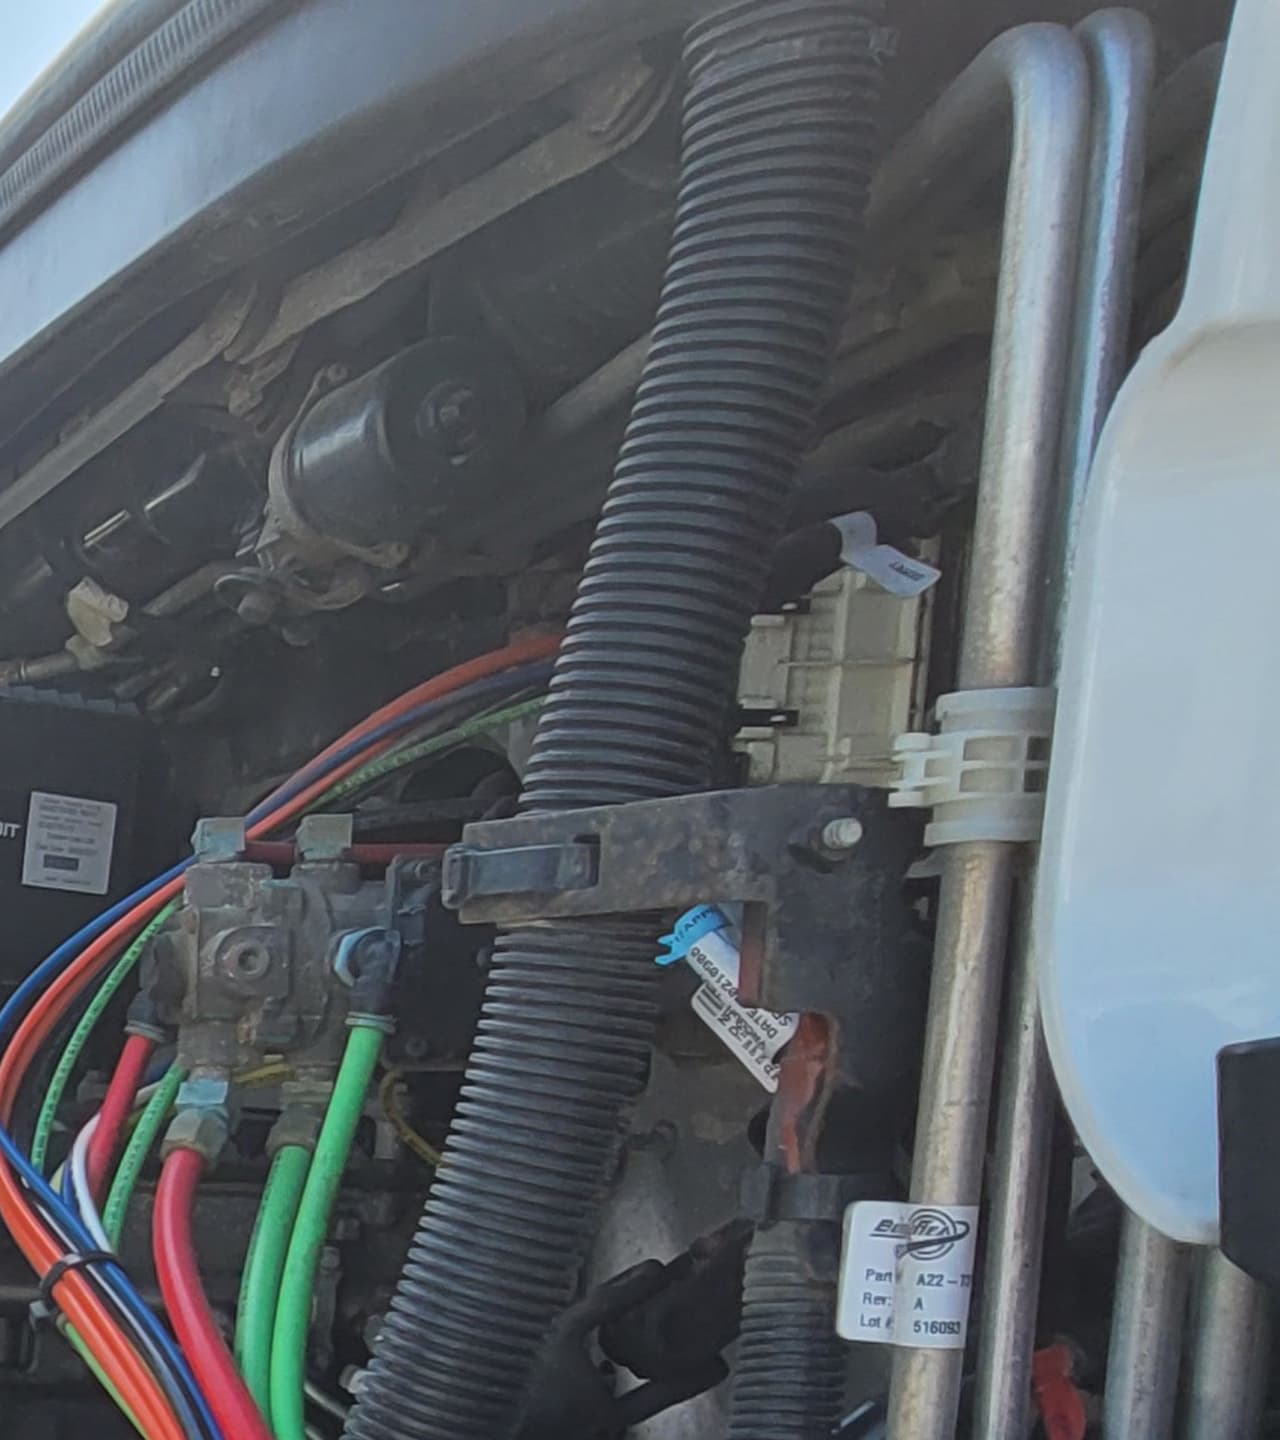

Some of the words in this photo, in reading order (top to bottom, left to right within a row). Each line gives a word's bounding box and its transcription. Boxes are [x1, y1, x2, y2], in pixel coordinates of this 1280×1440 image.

[865, 1268, 893, 1283] Part
[914, 1297, 923, 1310] A
[860, 1315, 881, 1329] Lot
